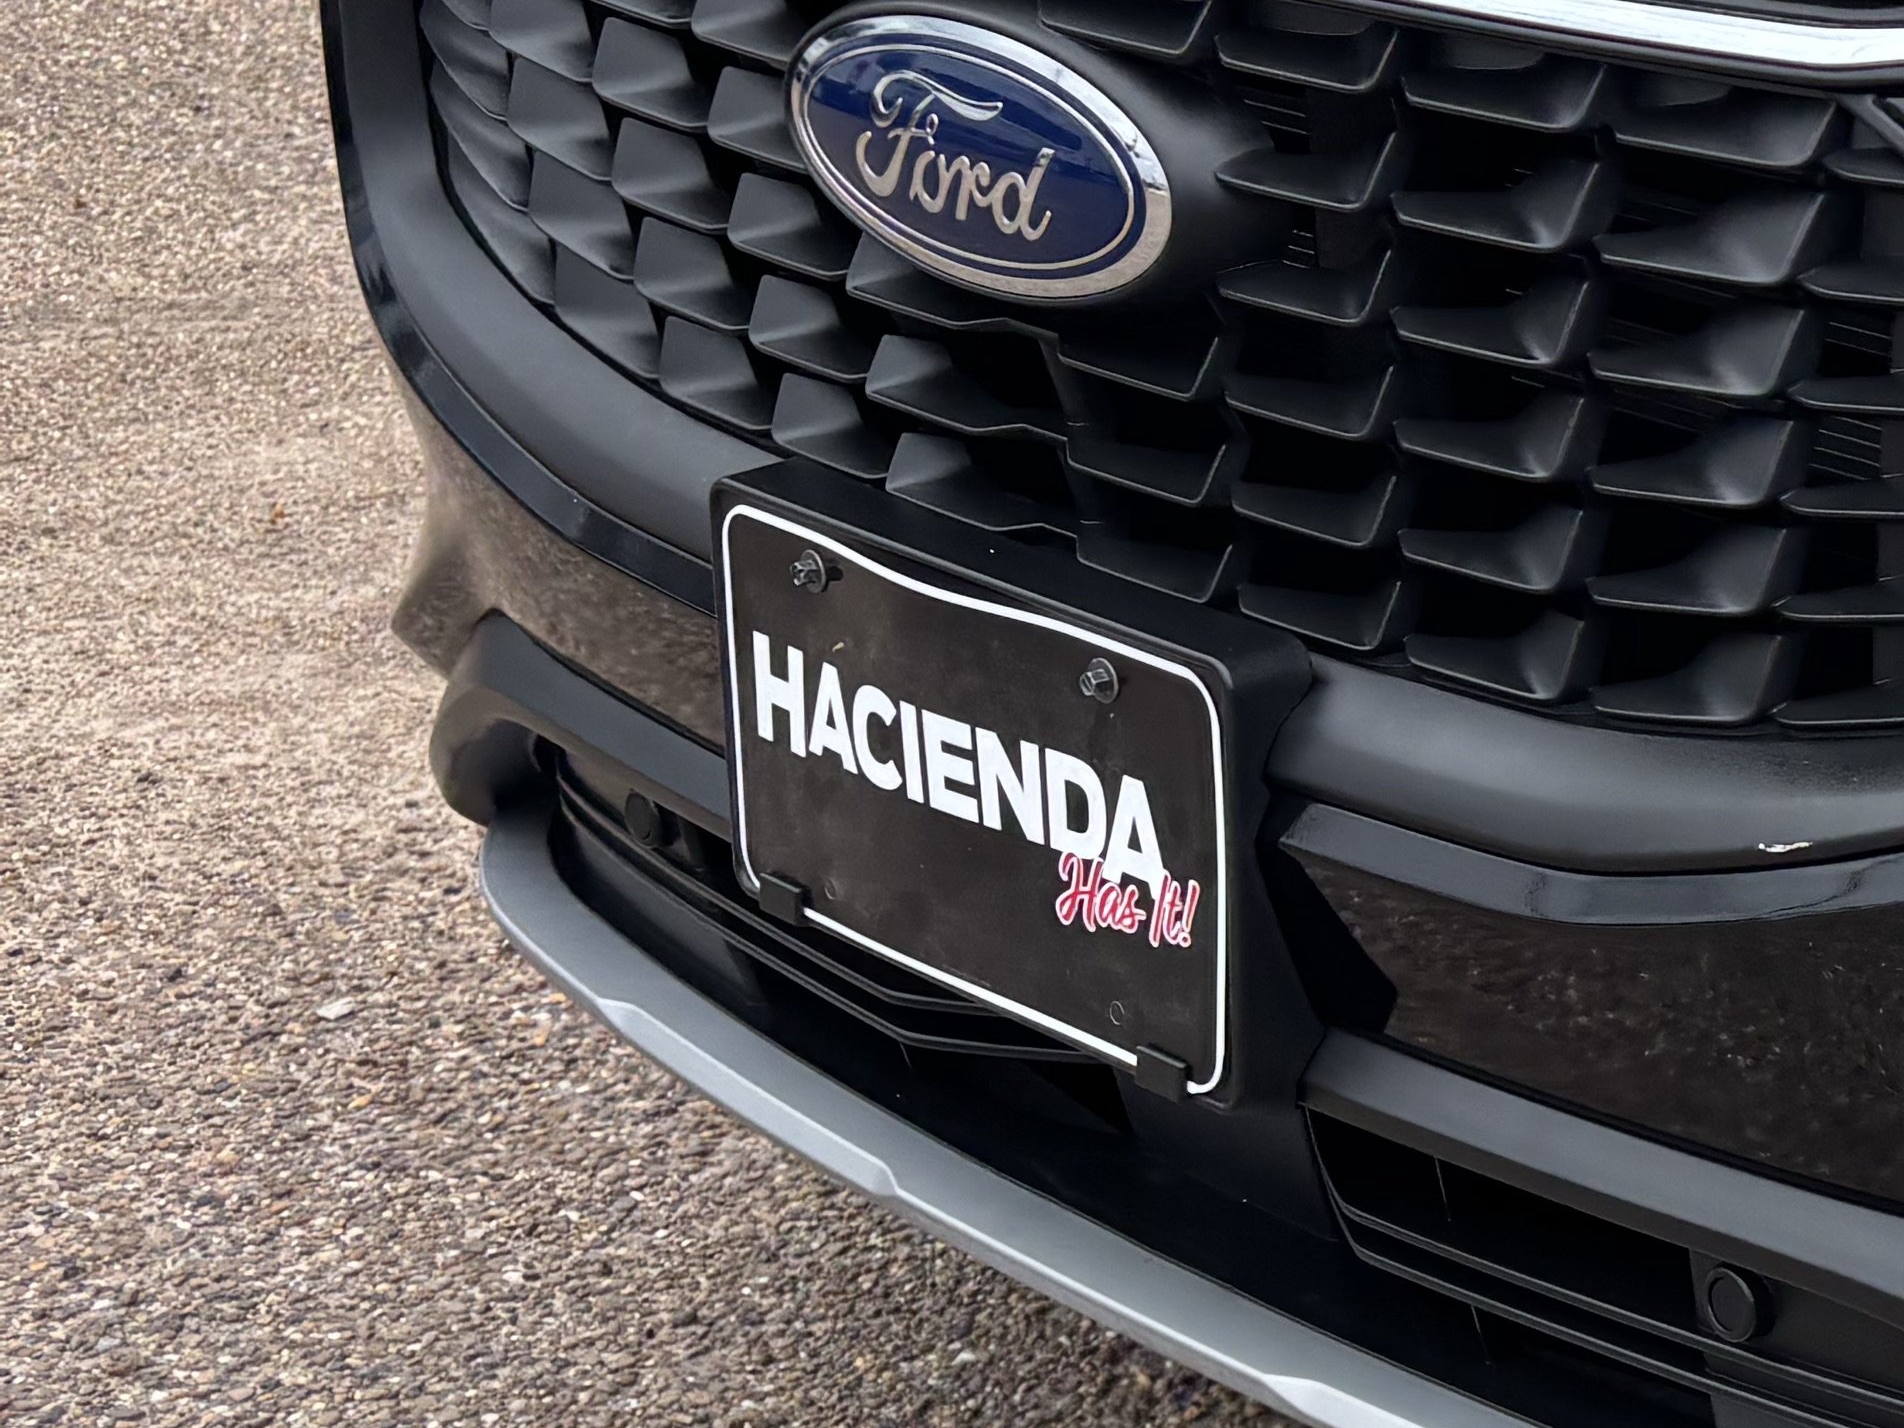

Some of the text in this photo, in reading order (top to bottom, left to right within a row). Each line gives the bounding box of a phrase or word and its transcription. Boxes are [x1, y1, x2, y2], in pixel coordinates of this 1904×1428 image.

[856, 70, 1055, 241] Ford
[752, 630, 1170, 897] HACIENDA
[1056, 852, 1200, 947] Has It!
